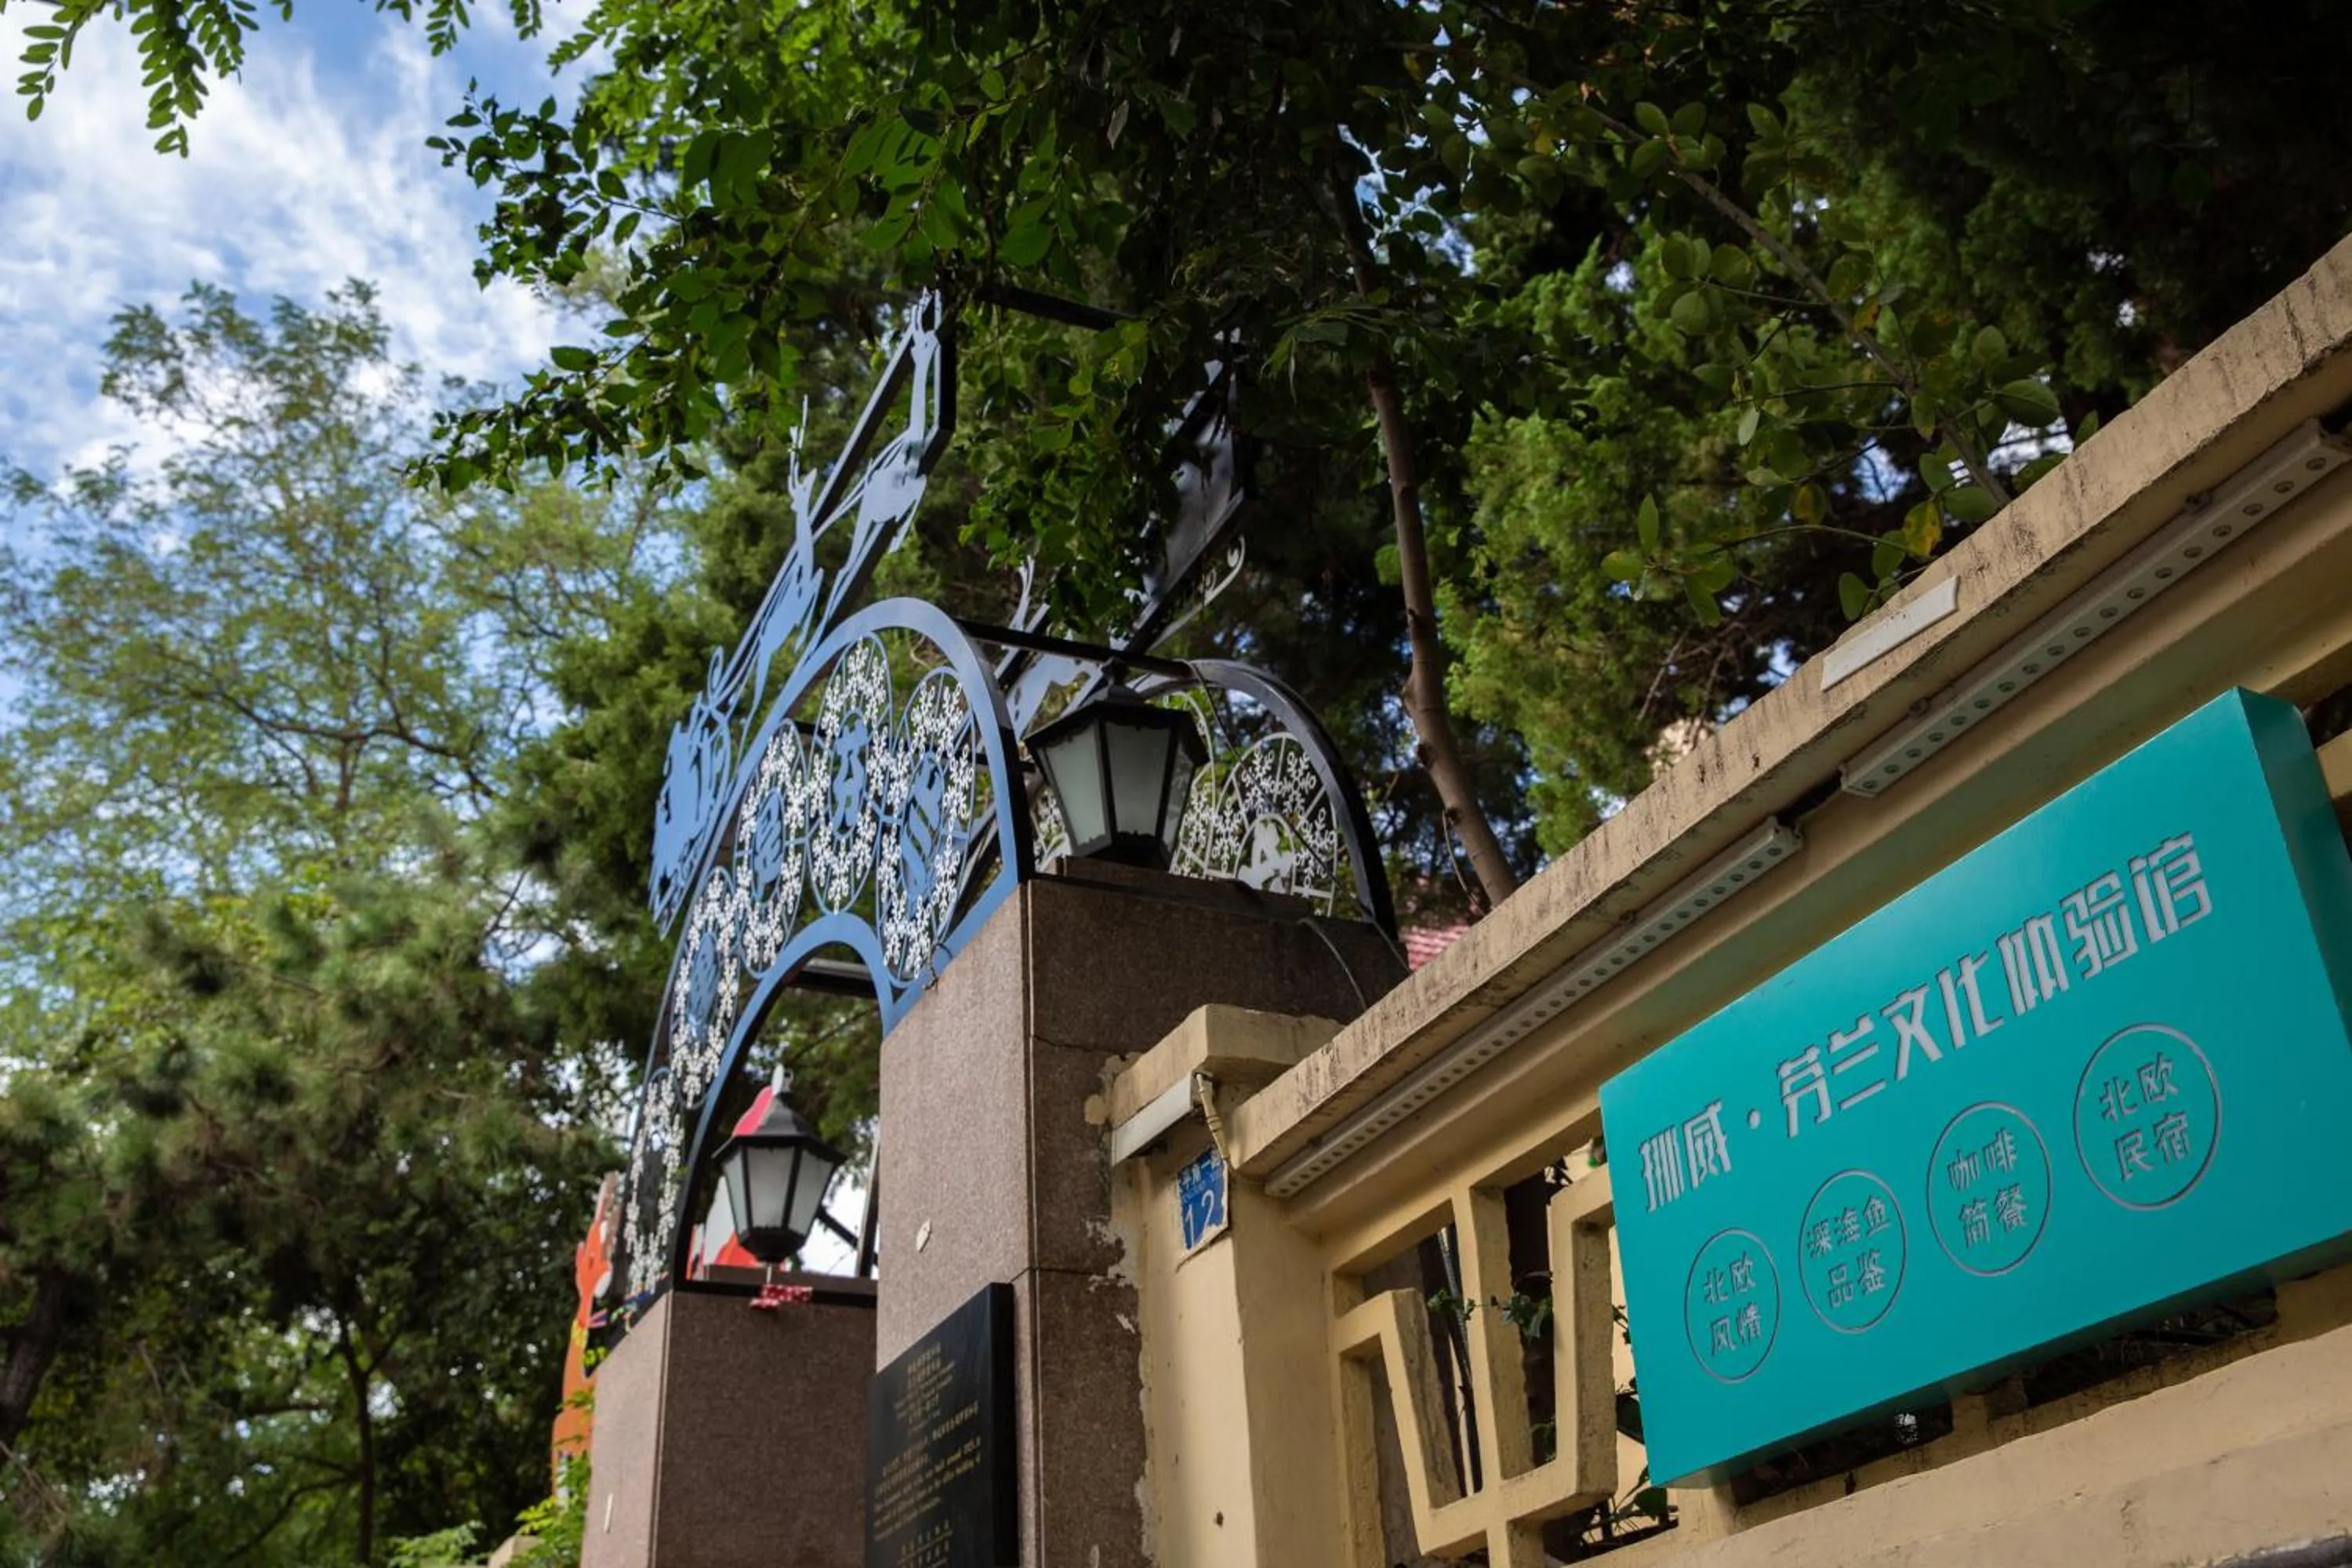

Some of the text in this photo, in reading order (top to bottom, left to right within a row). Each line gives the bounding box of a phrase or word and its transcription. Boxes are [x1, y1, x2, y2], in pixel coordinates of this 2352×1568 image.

[2099, 1051, 2179, 1123] 北欧
[1947, 1127, 2018, 1192] 咖啡
[2114, 1110, 2192, 1182] 民宿
[1806, 1194, 1890, 1258] 深海鱼
[1958, 1181, 2029, 1249] 简餐
[1704, 1250, 1756, 1305] 北欧
[1828, 1248, 1886, 1309] 品鉴
[1710, 1301, 1762, 1357] 风情
